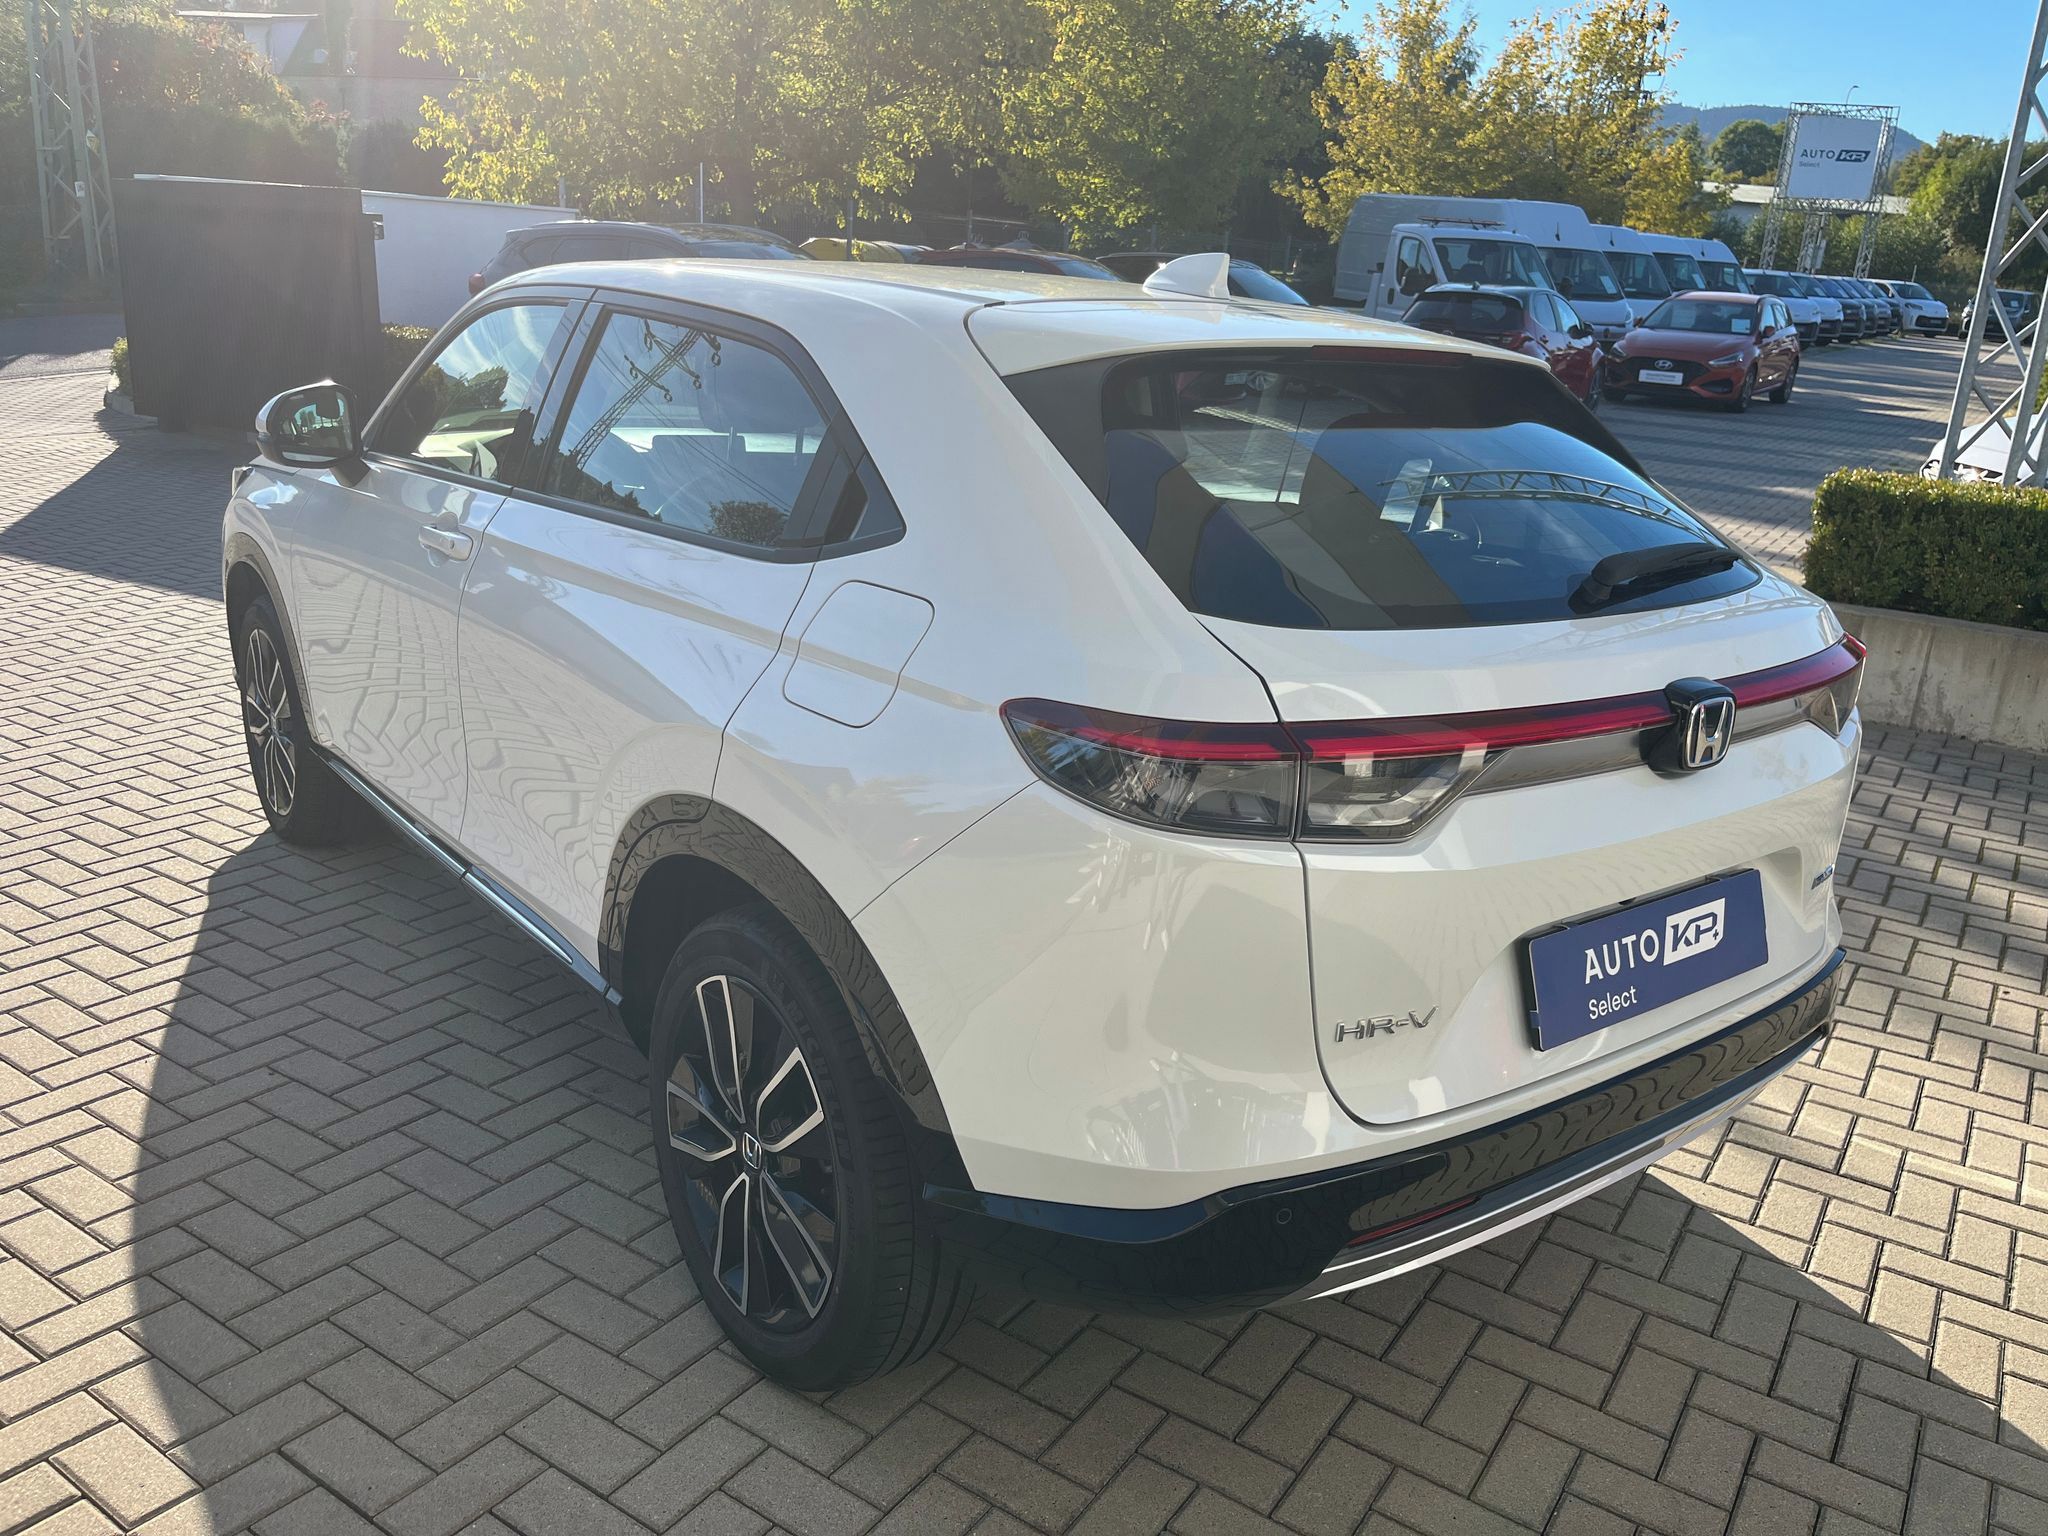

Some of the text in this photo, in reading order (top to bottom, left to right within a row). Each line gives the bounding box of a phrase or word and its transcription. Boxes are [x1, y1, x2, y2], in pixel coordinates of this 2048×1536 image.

[1800, 149, 1835, 159] AUTO
[1585, 929, 1660, 984] AUTO
[1588, 985, 1638, 1020] Select
[1335, 1005, 1439, 1042] HR-V
